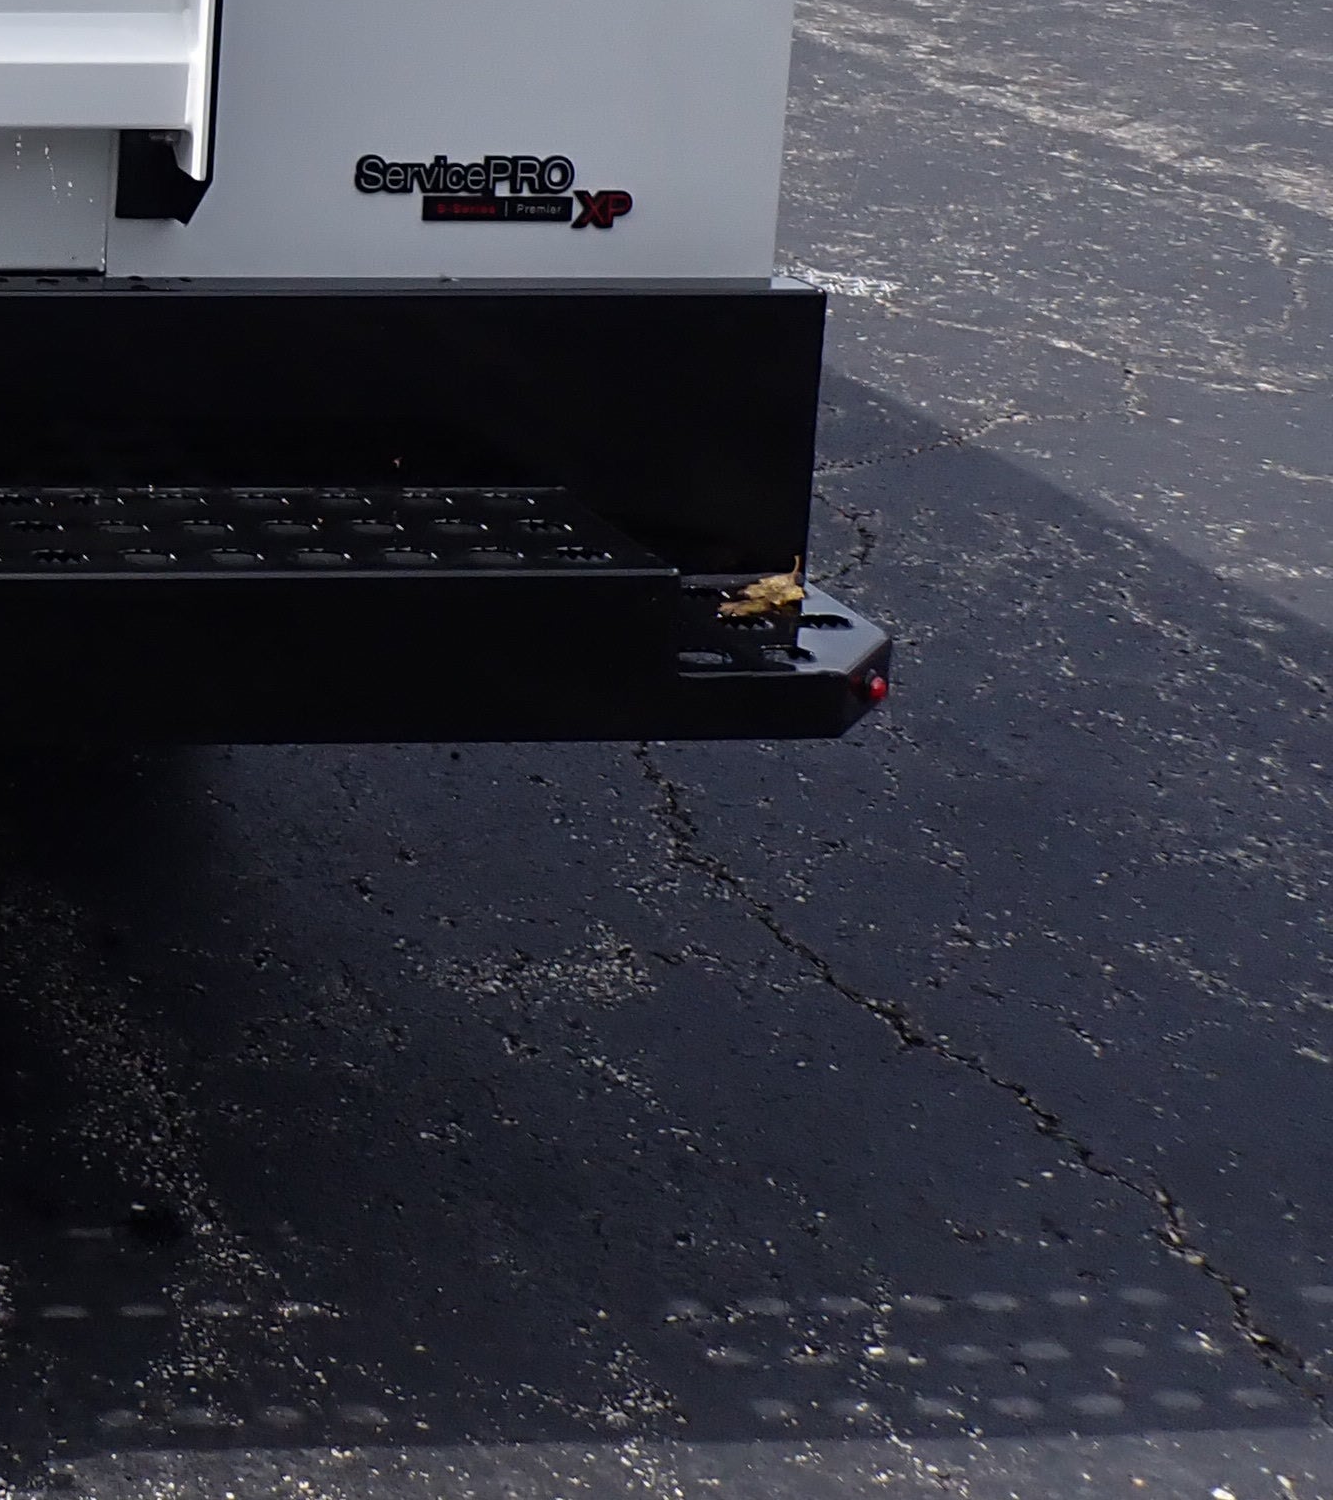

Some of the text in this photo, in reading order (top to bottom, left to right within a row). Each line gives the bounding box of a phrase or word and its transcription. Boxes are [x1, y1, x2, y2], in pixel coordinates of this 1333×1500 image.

[358, 157, 574, 192] ServicePRO
[516, 203, 562, 214] Premier
[578, 192, 632, 226] XP
